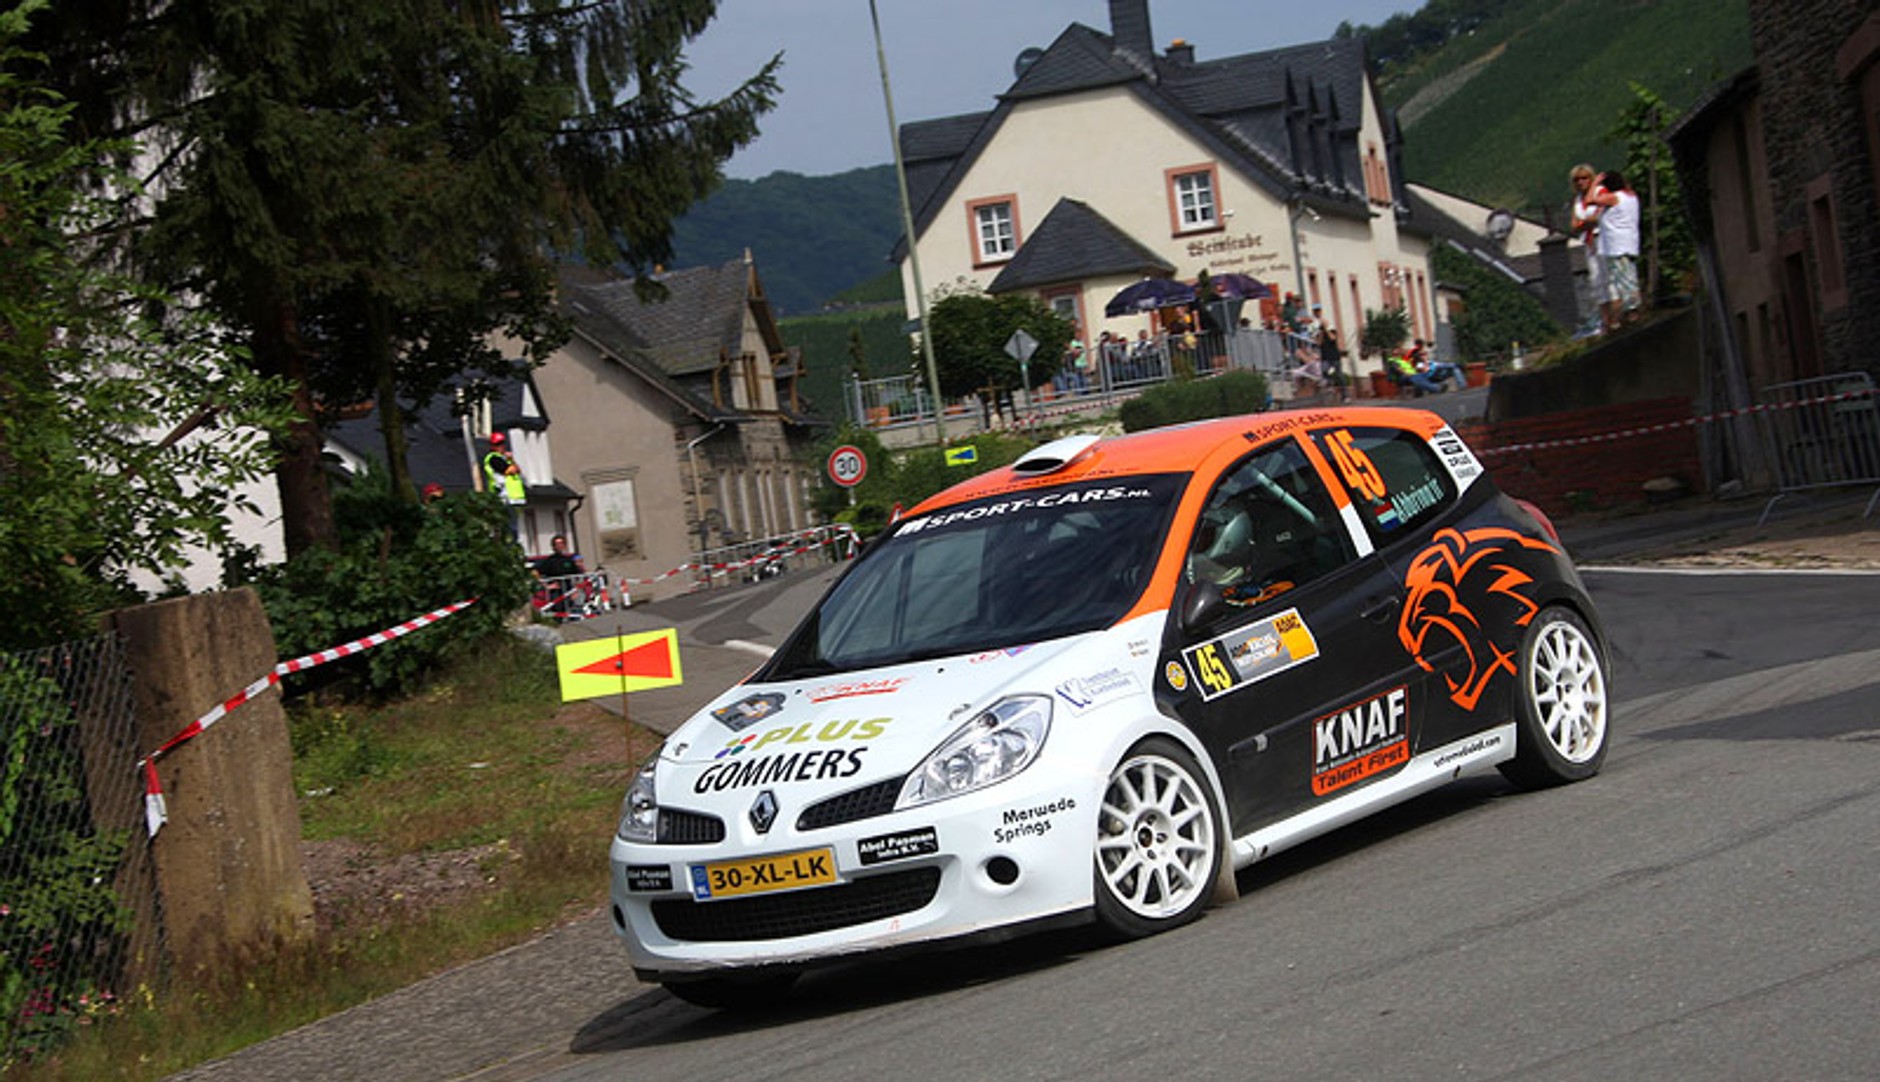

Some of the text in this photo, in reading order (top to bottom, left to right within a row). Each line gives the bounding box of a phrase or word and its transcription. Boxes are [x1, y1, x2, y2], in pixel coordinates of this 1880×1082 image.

[836, 456, 859, 476] 30
[1324, 429, 1387, 501] 45
[1195, 643, 1233, 692] 45
[751, 717, 893, 751] PLUS
[1315, 688, 1405, 765] KNAF
[694, 746, 868, 794] GOMMERS
[1317, 761, 1363, 790] Talent
[1367, 745, 1404, 771] First
[1003, 797, 1077, 825] Merwede
[993, 820, 1052, 844] Springs
[711, 856, 829, 890] 30-XL-LK
